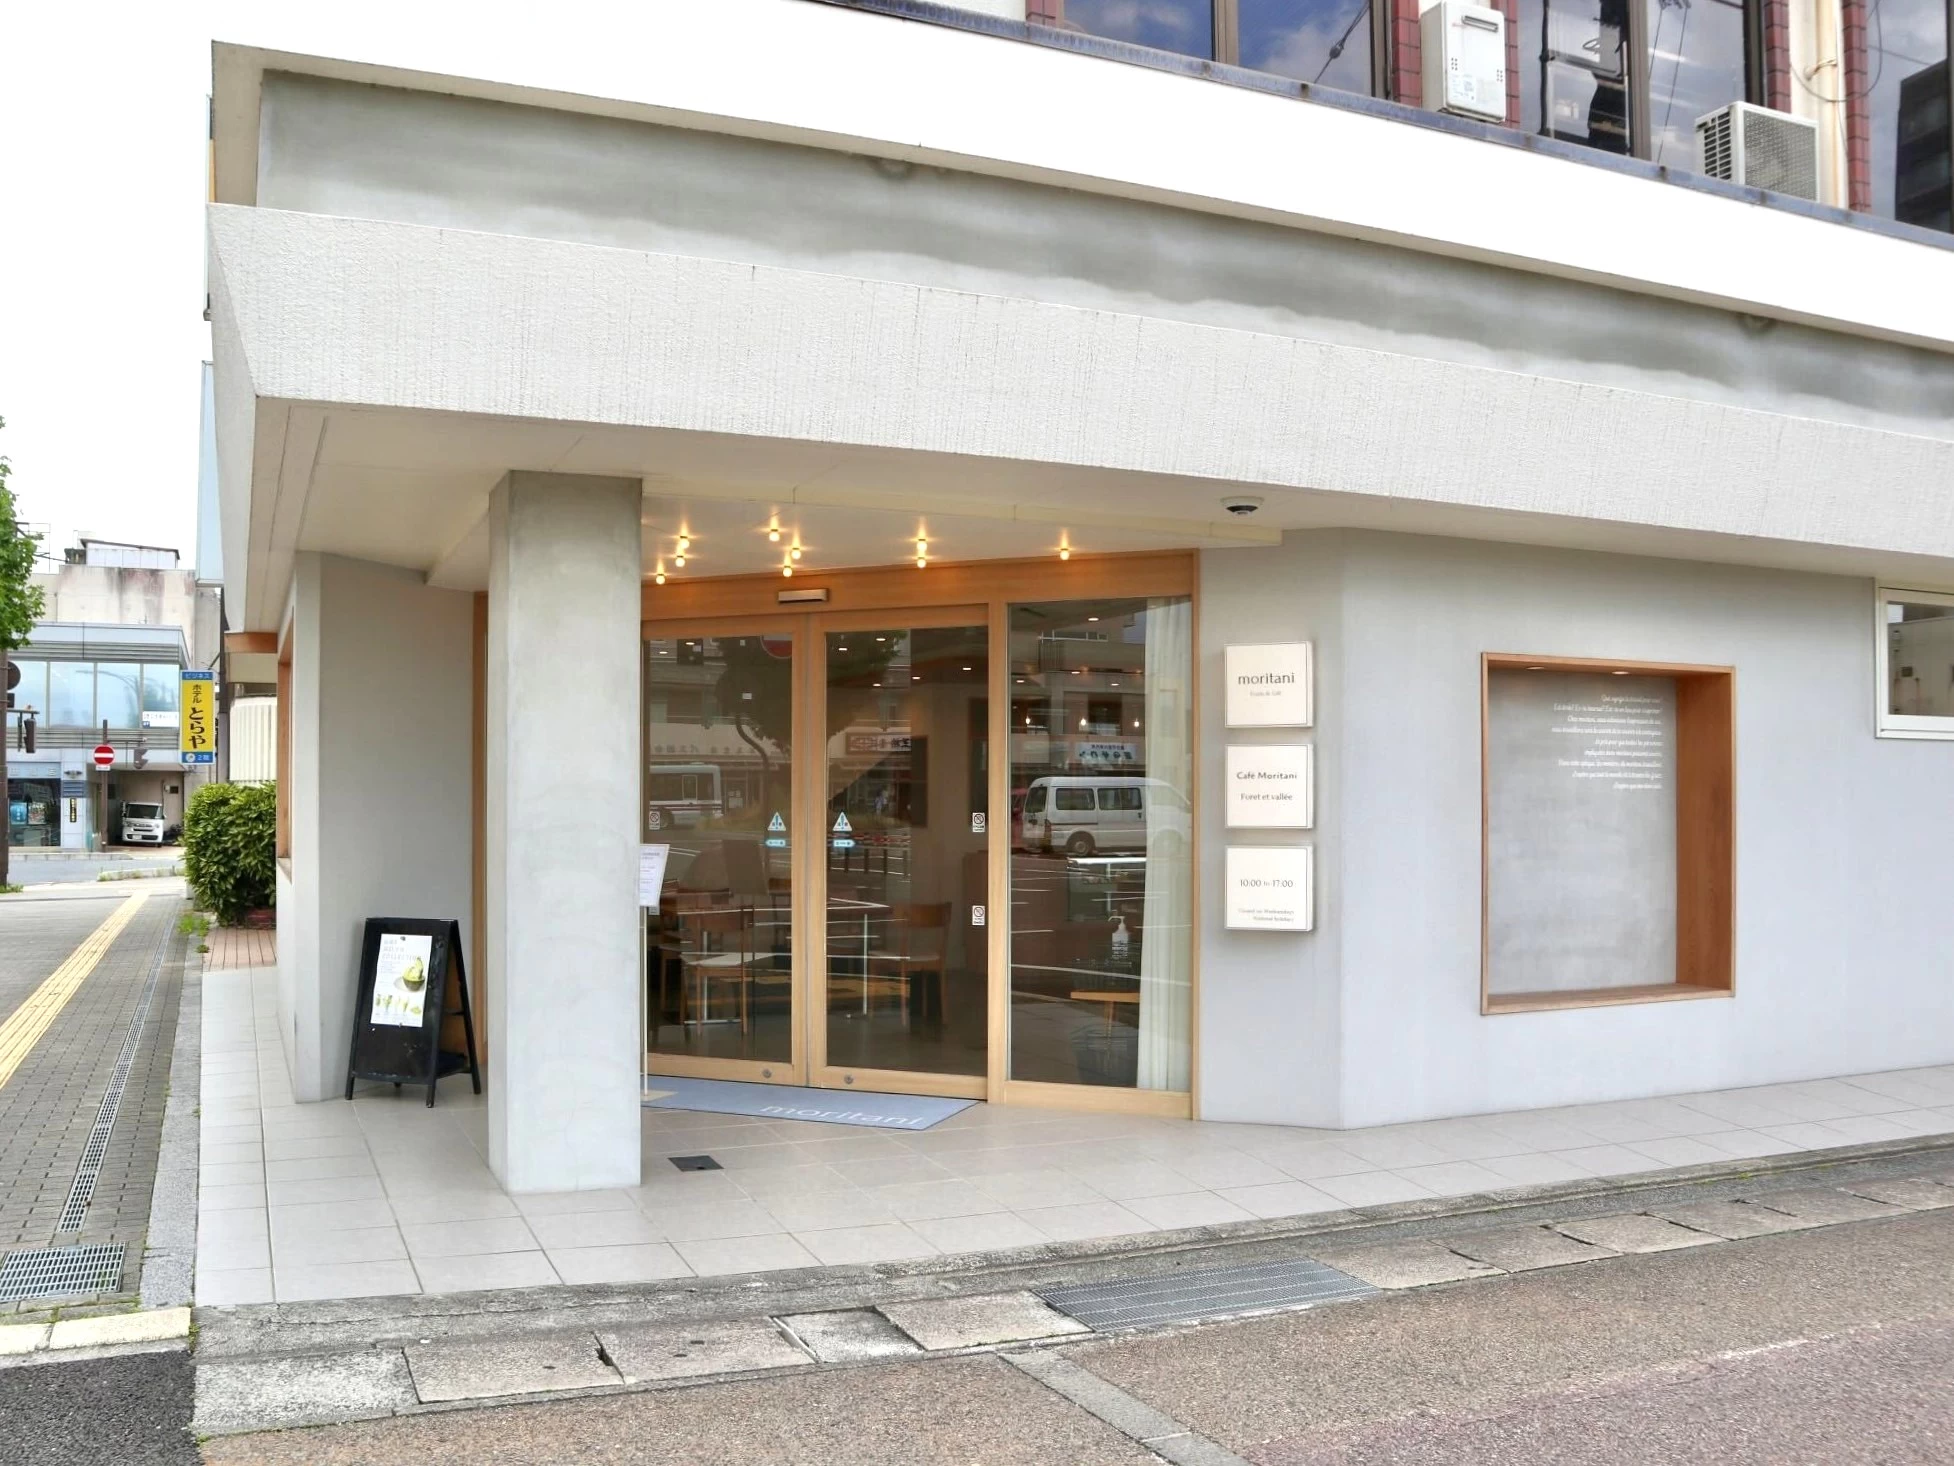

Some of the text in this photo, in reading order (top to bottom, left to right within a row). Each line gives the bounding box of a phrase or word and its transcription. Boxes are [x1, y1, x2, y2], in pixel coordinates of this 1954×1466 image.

[1237, 671, 1295, 685] moritani
[188, 684, 207, 749] ホテル とらや
[1257, 771, 1298, 780] Moritani
[1240, 879, 1262, 887] 10:00
[1272, 879, 1294, 888] 17:00
[760, 1104, 926, 1126] moritani
